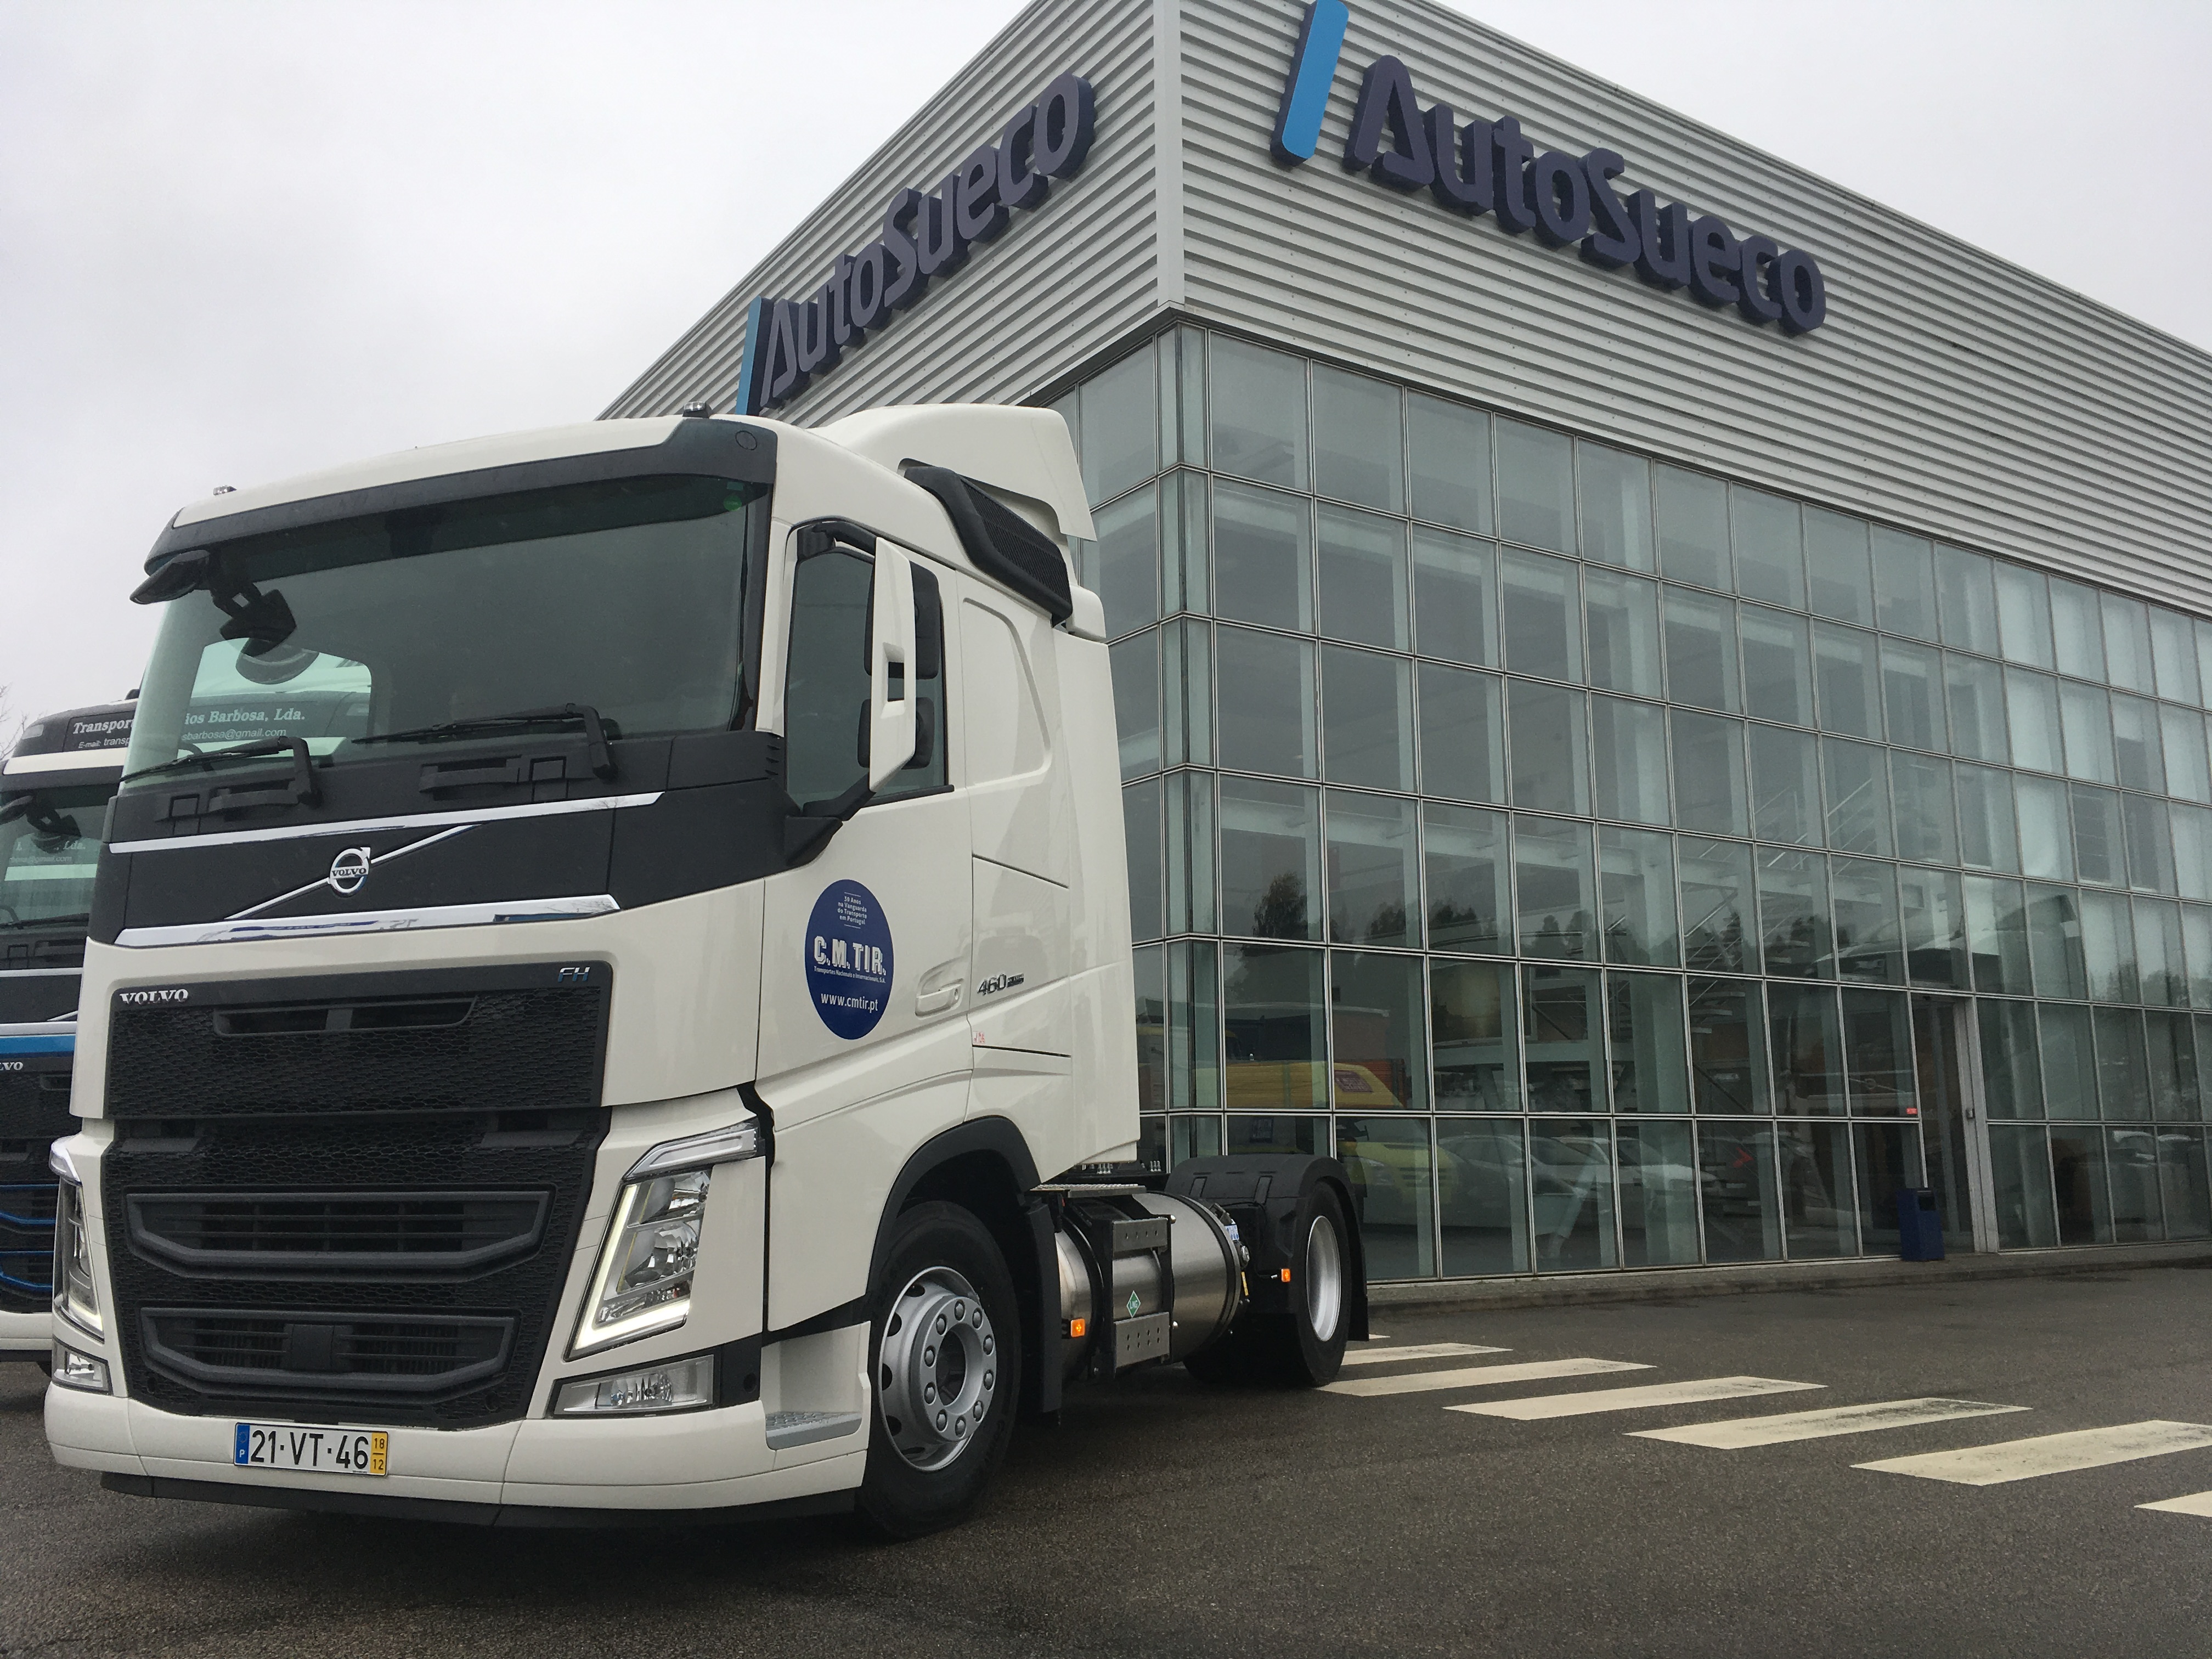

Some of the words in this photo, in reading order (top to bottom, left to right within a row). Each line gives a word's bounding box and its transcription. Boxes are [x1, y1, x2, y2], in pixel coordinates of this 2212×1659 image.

[1344, 54, 1826, 336] AutoSueco
[760, 71, 1095, 409] AutoSueco
[72, 718, 133, 734] Transpor
[208, 709, 268, 723] Barbosa,
[274, 708, 306, 720] Lda.
[78, 740, 101, 748] E-mail:
[104, 736, 131, 747] transp
[182, 728, 286, 741] sbarbosa@gmail.com
[331, 868, 366, 877] VOLVO
[844, 902, 867, 912] Vanguarda
[850, 897, 861, 905] Anos
[844, 908, 867, 919] Transporte
[847, 916, 866, 926] Portugal
[557, 967, 590, 983] FH
[814, 966, 836, 975] Transportes
[977, 973, 1007, 996] 460
[119, 989, 189, 1005] VOLVO
[821, 993, 878, 1013] www.cmtir.pt
[374, 1437, 385, 1449] 18
[239, 1449, 245, 1458] P
[373, 1458, 384, 1470] 12
